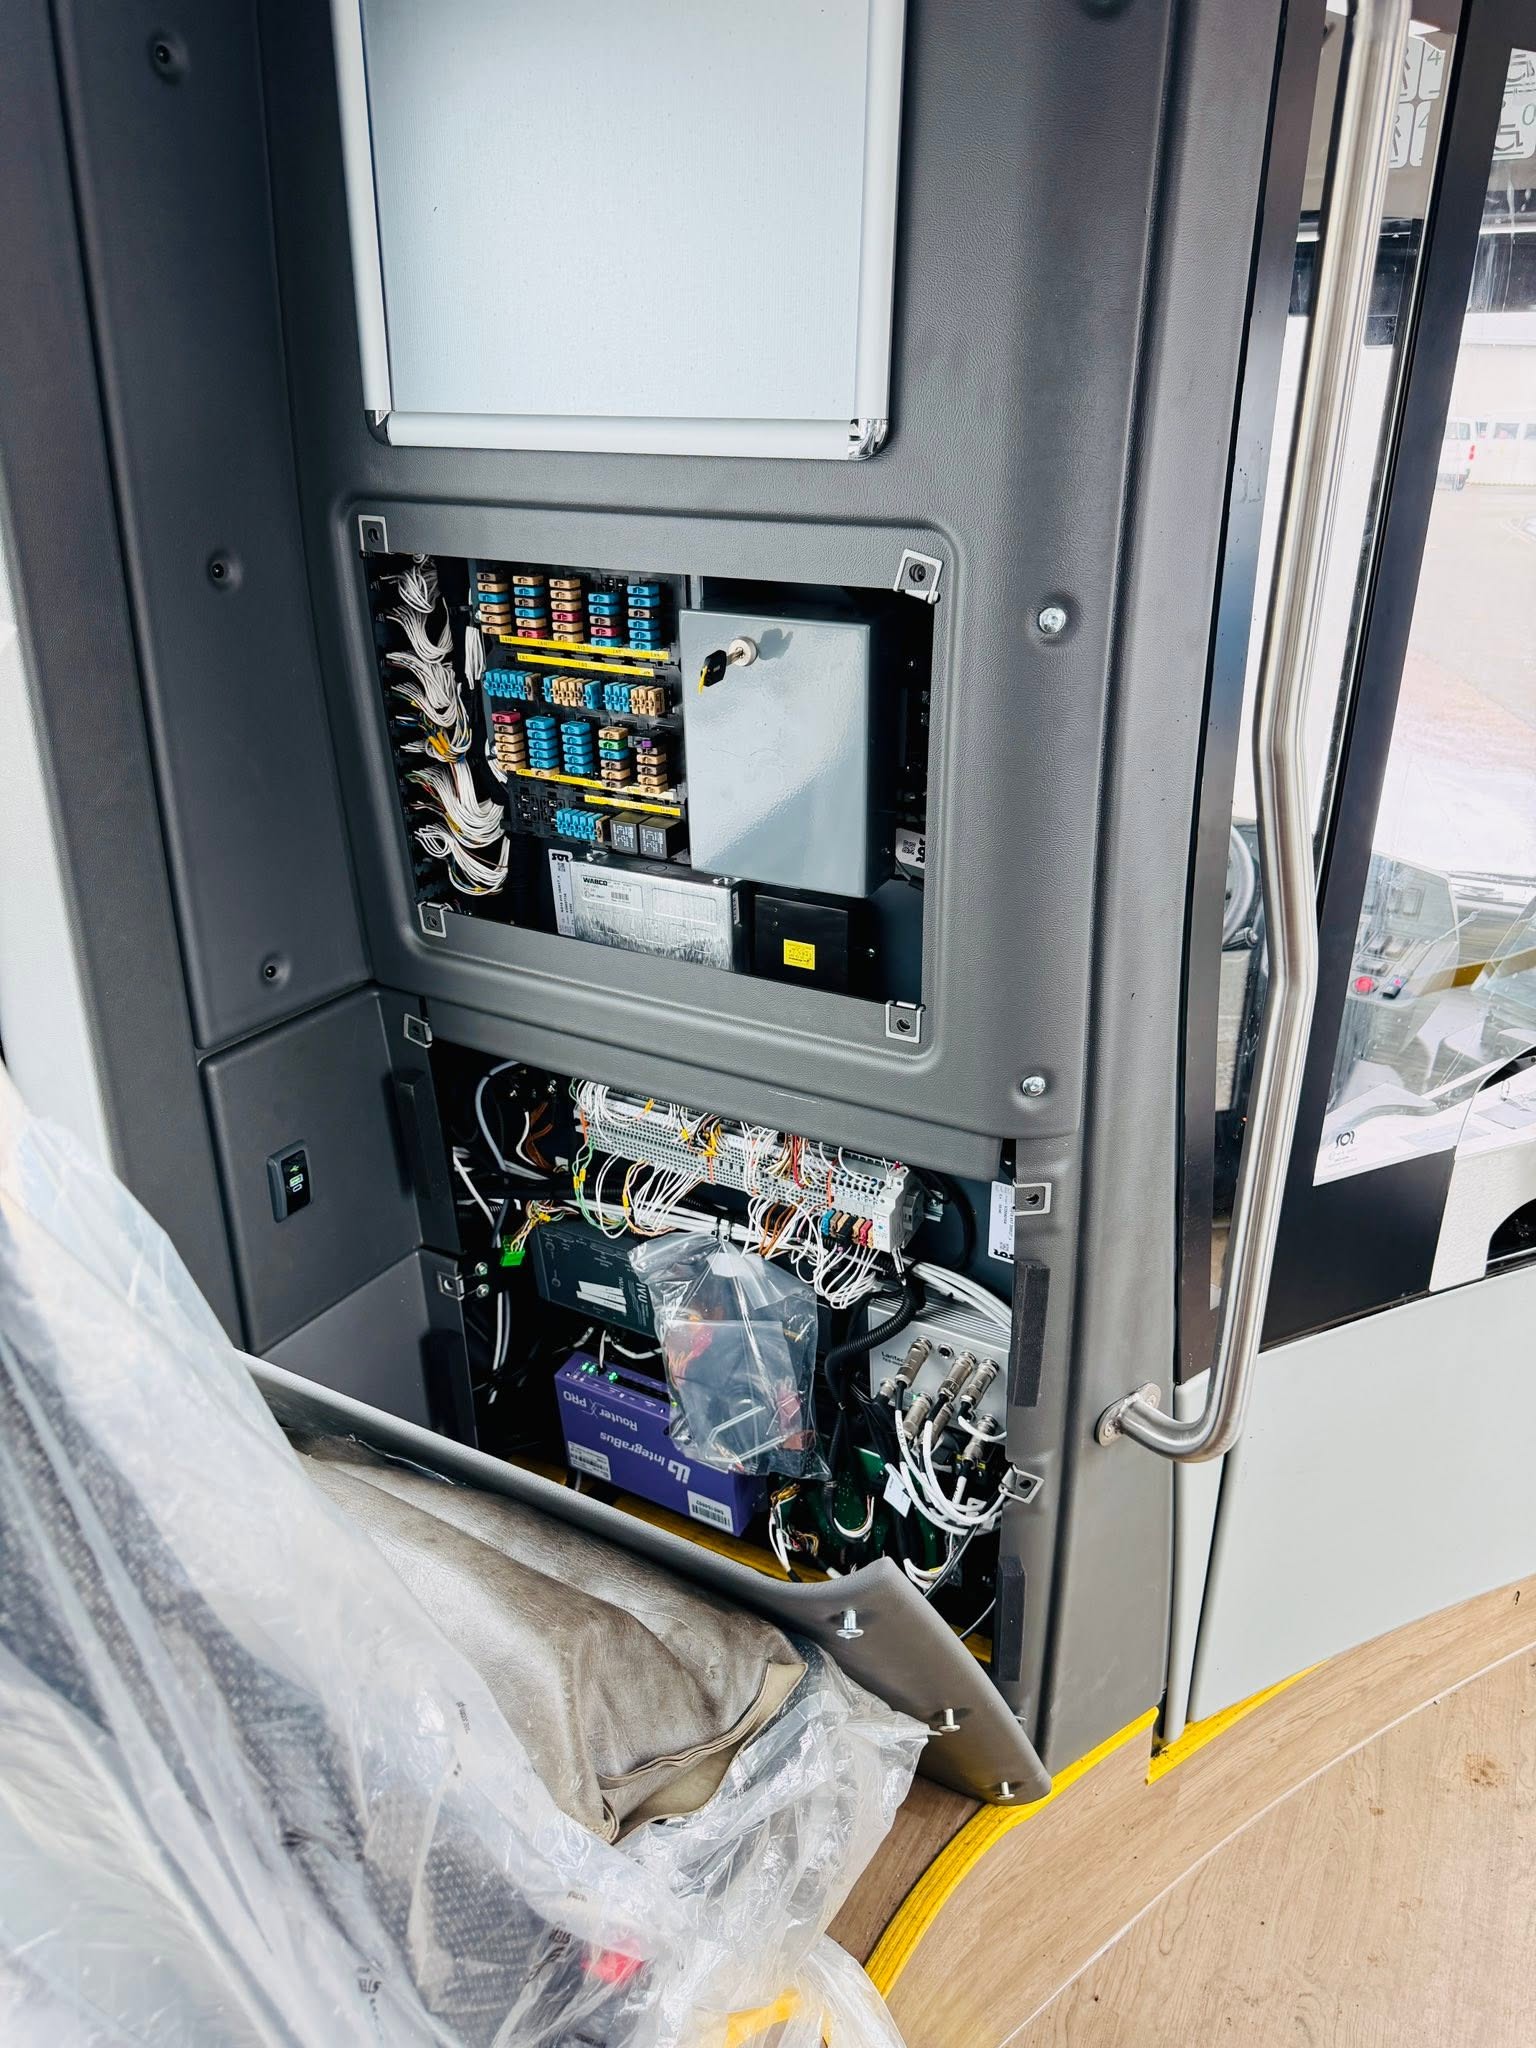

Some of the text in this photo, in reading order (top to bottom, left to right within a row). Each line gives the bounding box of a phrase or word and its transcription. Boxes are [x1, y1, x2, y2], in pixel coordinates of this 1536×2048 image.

[551, 853, 570, 862] SOR
[583, 877, 608, 887] WABCO
[636, 1282, 648, 1304] IVU
[881, 1351, 905, 1363] Lantec
[563, 1390, 587, 1407] PRO
[599, 1408, 638, 1432] Router
[600, 1431, 665, 1466] IntegraBus
